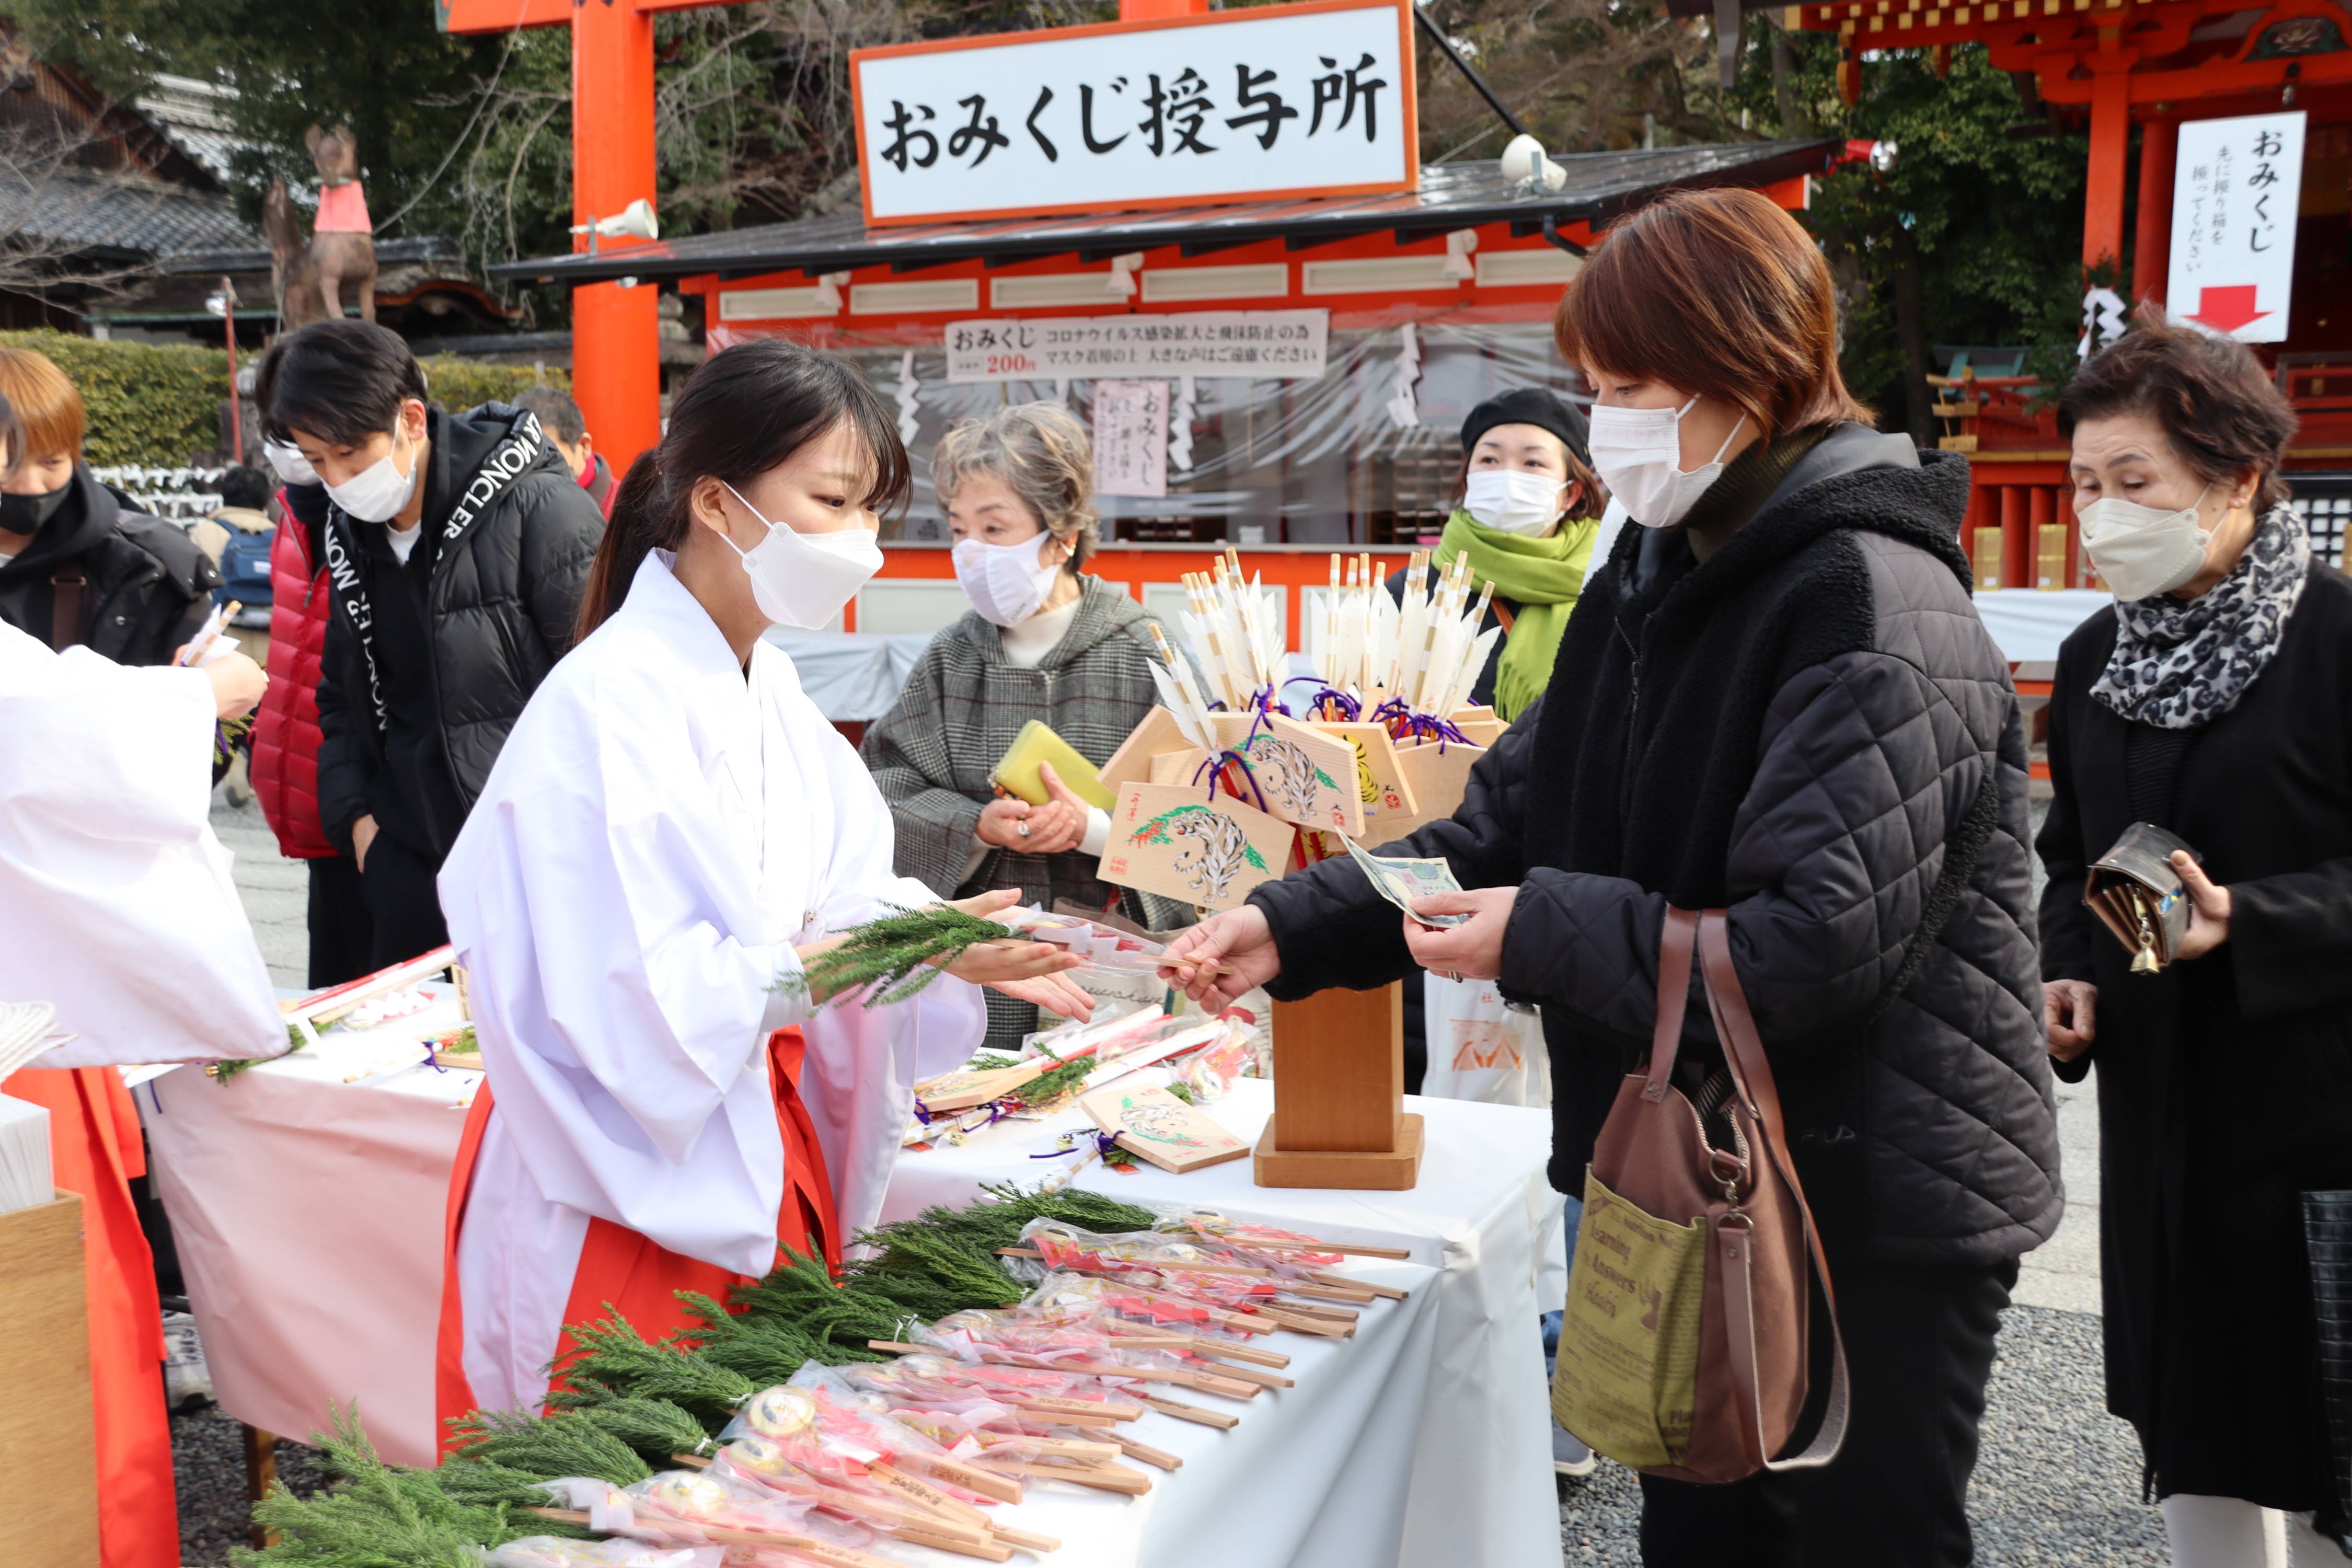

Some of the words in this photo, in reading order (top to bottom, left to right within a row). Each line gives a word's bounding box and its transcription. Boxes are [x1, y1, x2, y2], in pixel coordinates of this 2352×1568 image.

[881, 53, 1387, 172] おみくじ授与所
[2249, 131, 2282, 252] おみくじ
[954, 327, 1035, 352] おみくじ
[1046, 348, 1137, 364] マスク着用の上
[1138, 391, 1160, 486] おみくじ
[443, 439, 537, 539] MONCLER
